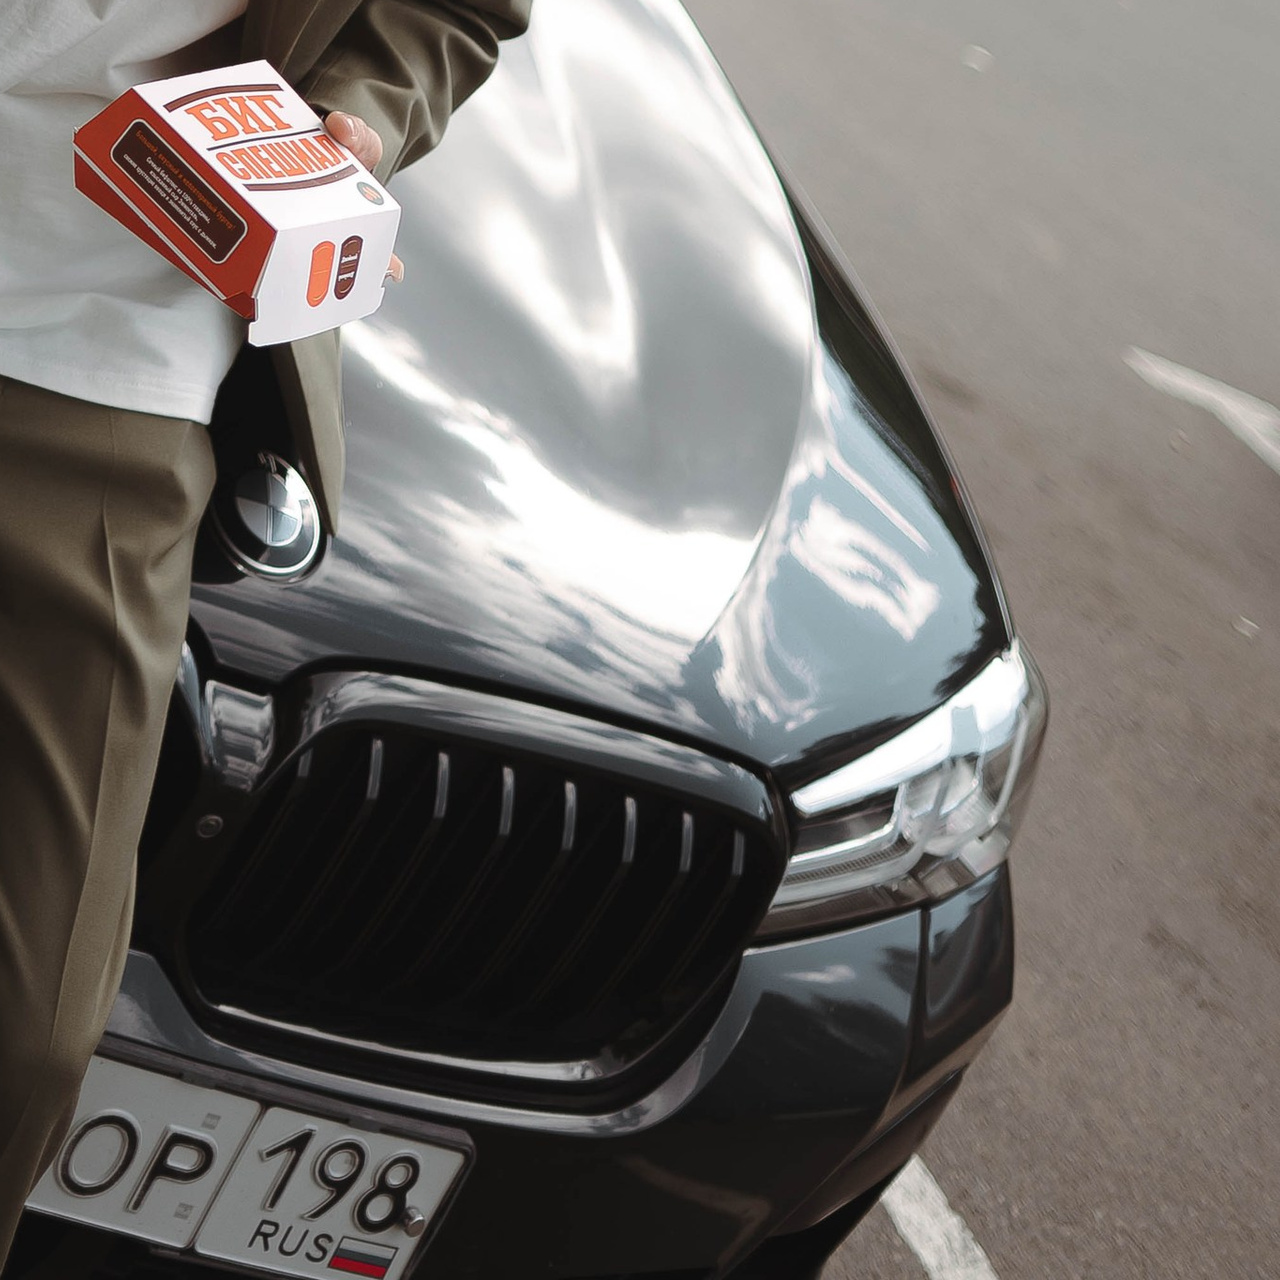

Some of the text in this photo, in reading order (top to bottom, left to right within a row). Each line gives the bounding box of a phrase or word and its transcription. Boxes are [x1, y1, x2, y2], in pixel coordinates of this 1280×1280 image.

[184, 94, 293, 141] БИГ
[215, 133, 349, 180] СПЕШИАЛ
[258, 1125, 422, 1235] 198
[248, 1219, 334, 1263] RUS
